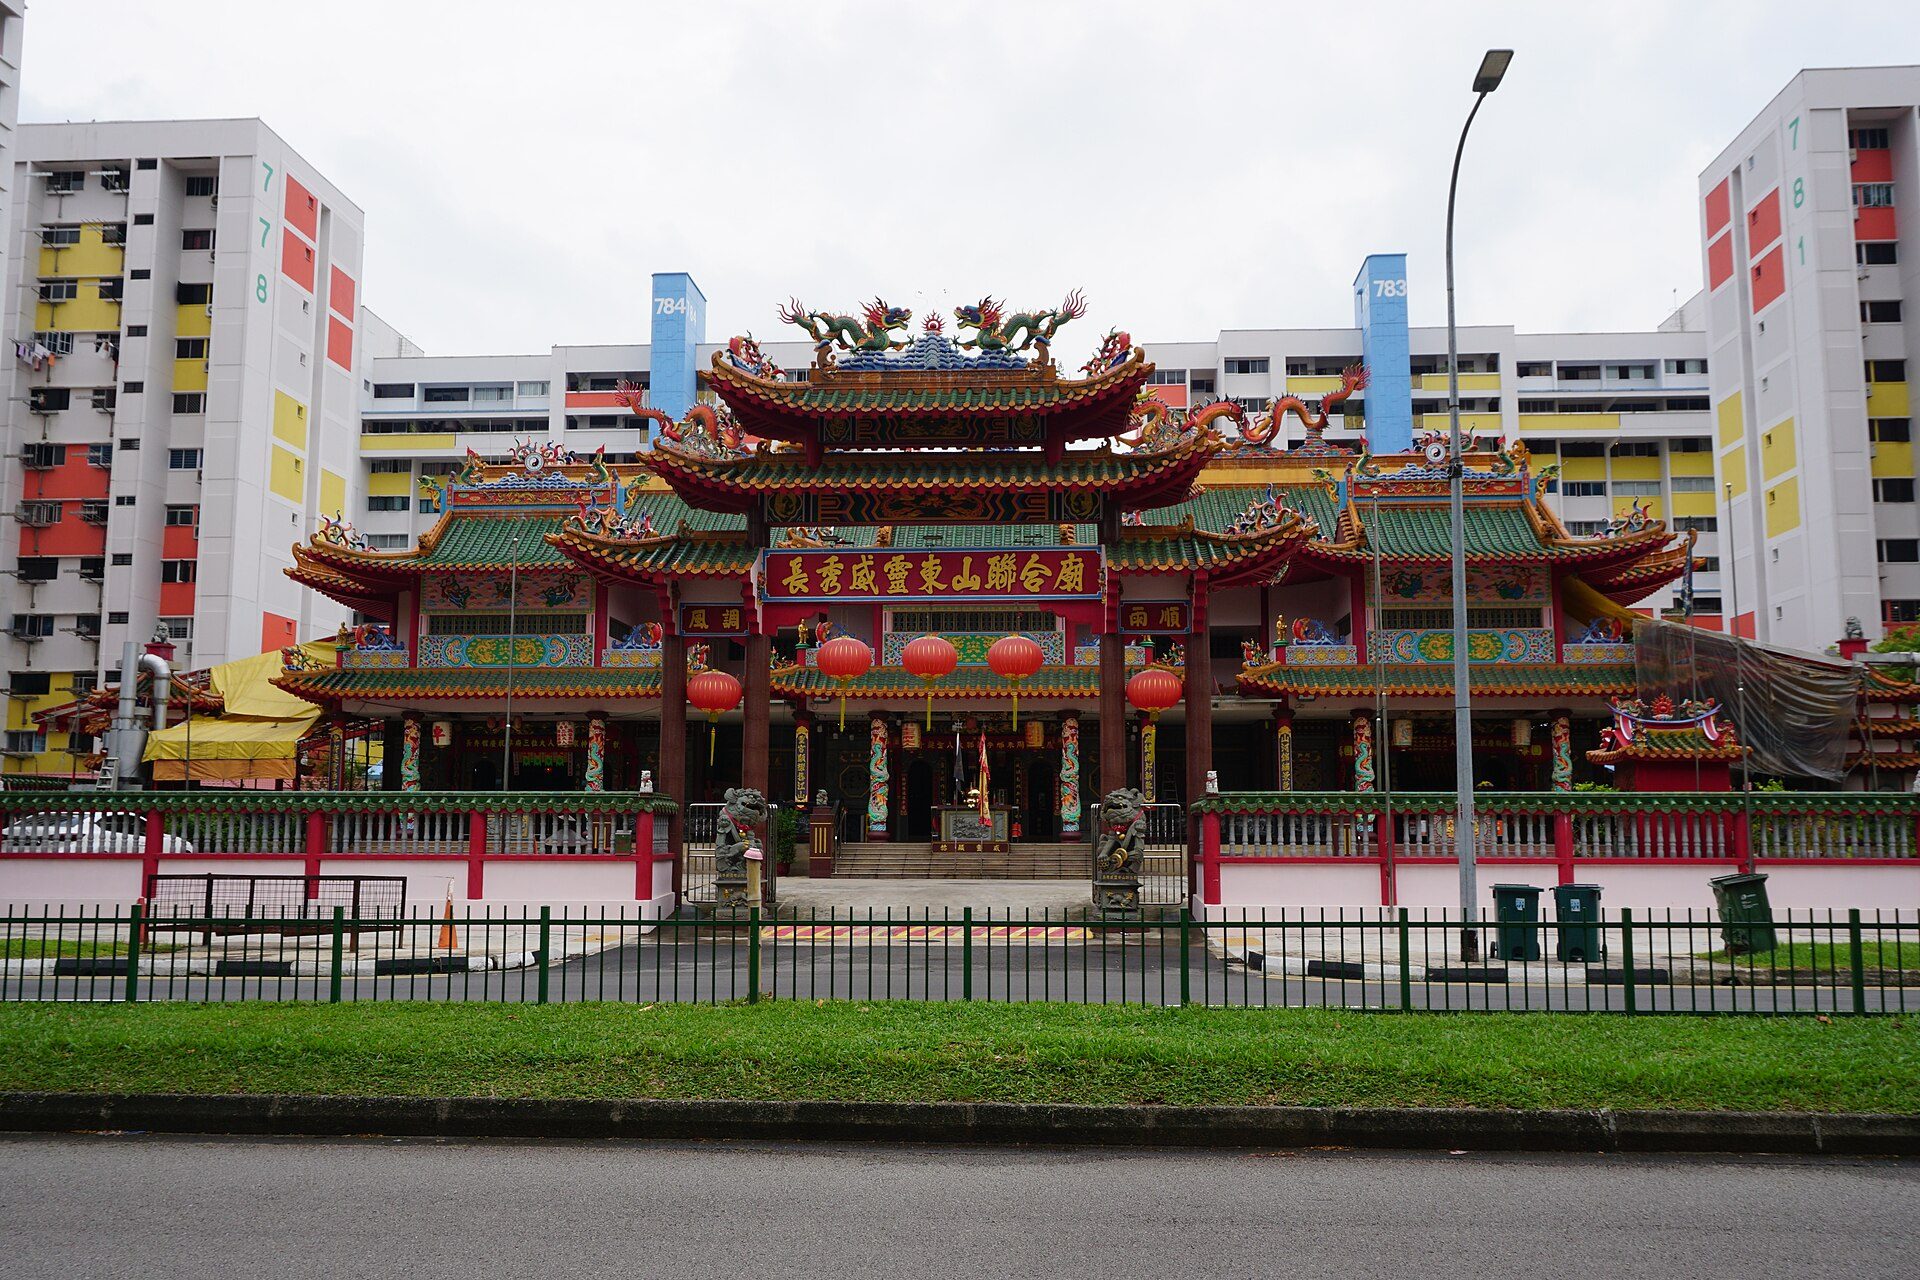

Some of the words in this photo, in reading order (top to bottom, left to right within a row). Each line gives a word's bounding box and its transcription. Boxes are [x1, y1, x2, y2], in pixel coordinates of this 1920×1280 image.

[1373, 279, 1407, 297] 783
[654, 297, 686, 315] 784
[781, 552, 1085, 595] 長秀威靈東山聯合廟
